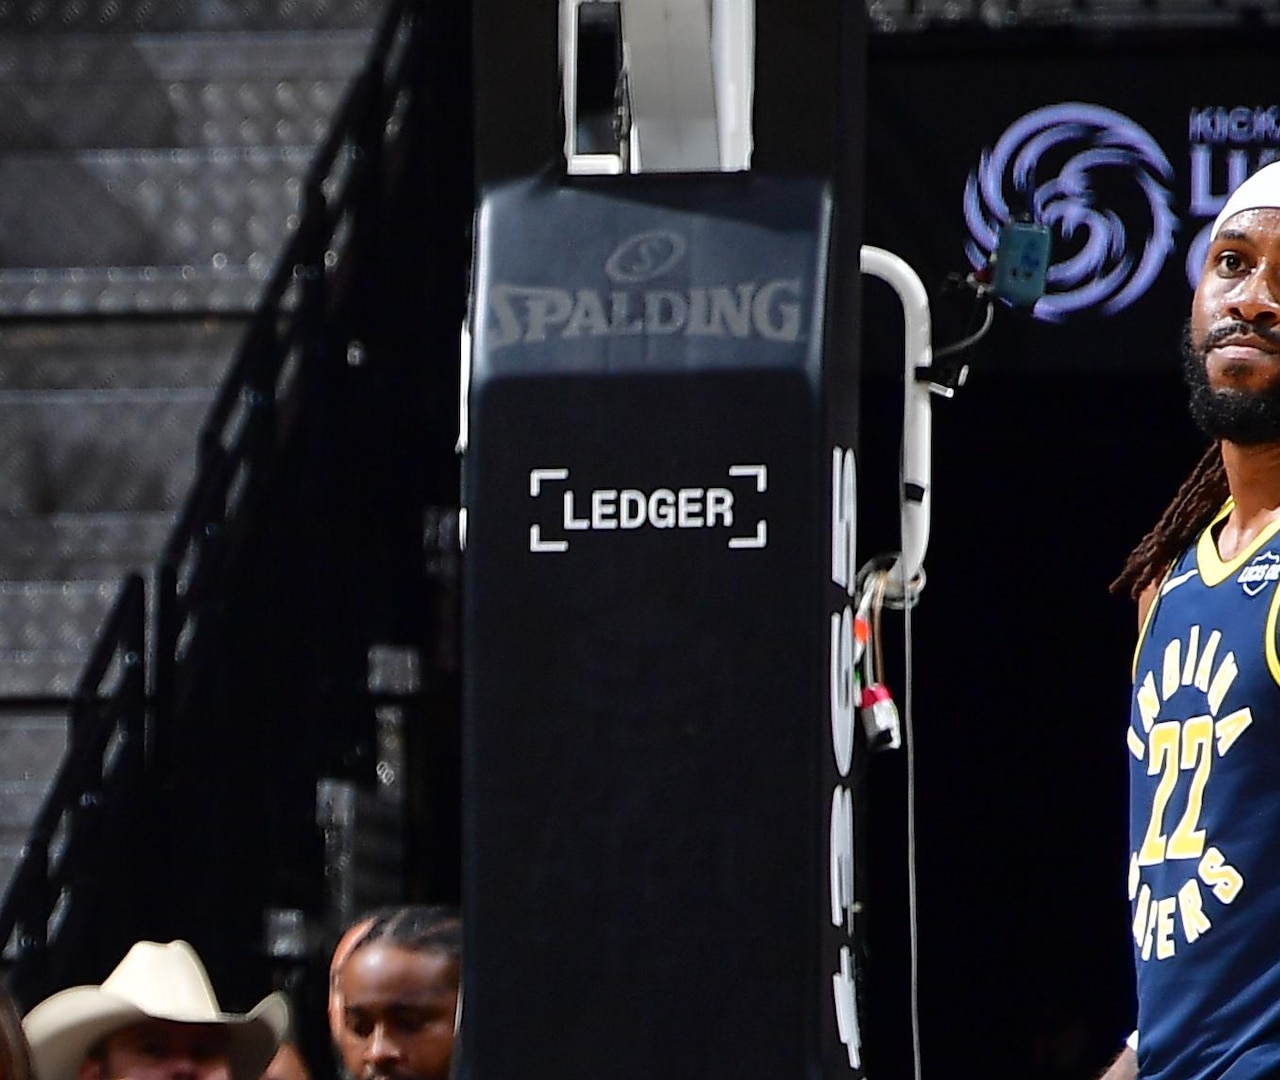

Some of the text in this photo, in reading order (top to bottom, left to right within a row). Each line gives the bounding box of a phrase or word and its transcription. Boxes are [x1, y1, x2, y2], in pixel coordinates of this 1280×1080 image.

[488, 279, 801, 349] SPALDING
[563, 487, 735, 530] LEDGER
[1127, 624, 1253, 758] INDIANA
[1137, 714, 1215, 867] 22
